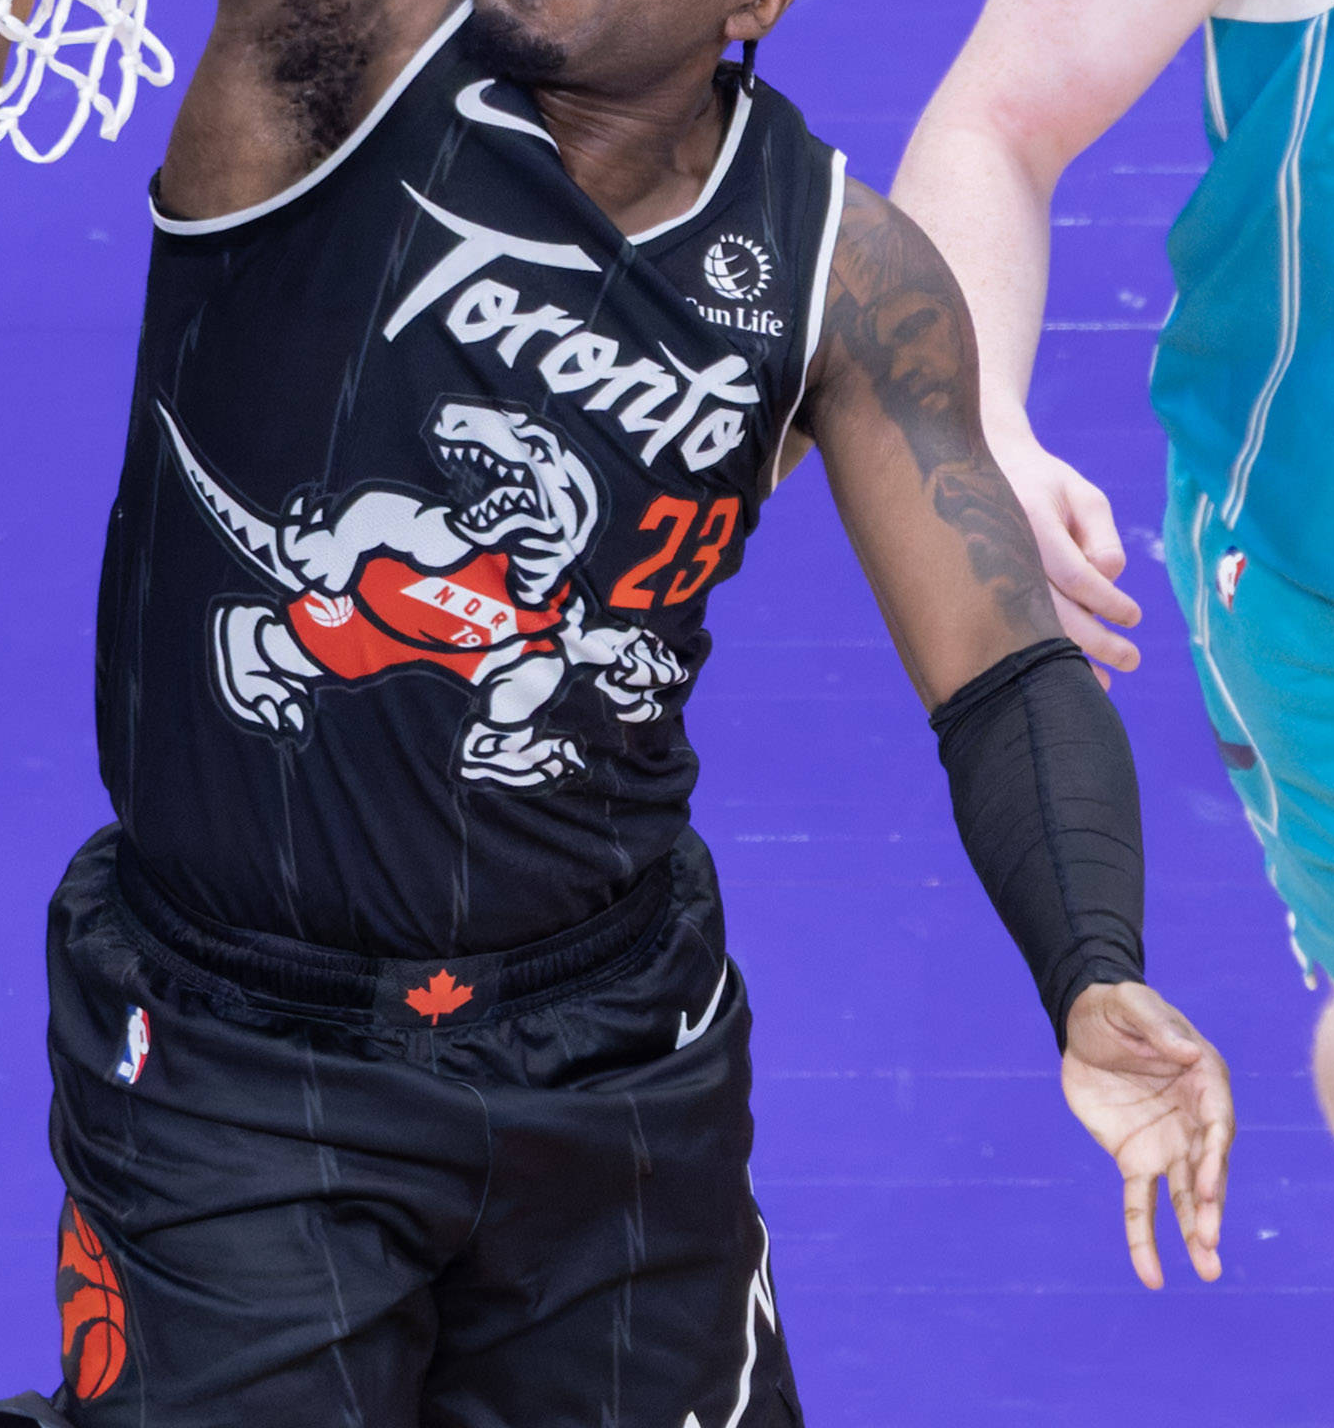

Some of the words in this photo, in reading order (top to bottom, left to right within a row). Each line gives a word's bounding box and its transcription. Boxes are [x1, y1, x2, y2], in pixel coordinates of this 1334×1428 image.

[383, 180, 760, 472] Toronto
[736, 307, 784, 337] Life
[609, 495, 740, 610] 23
